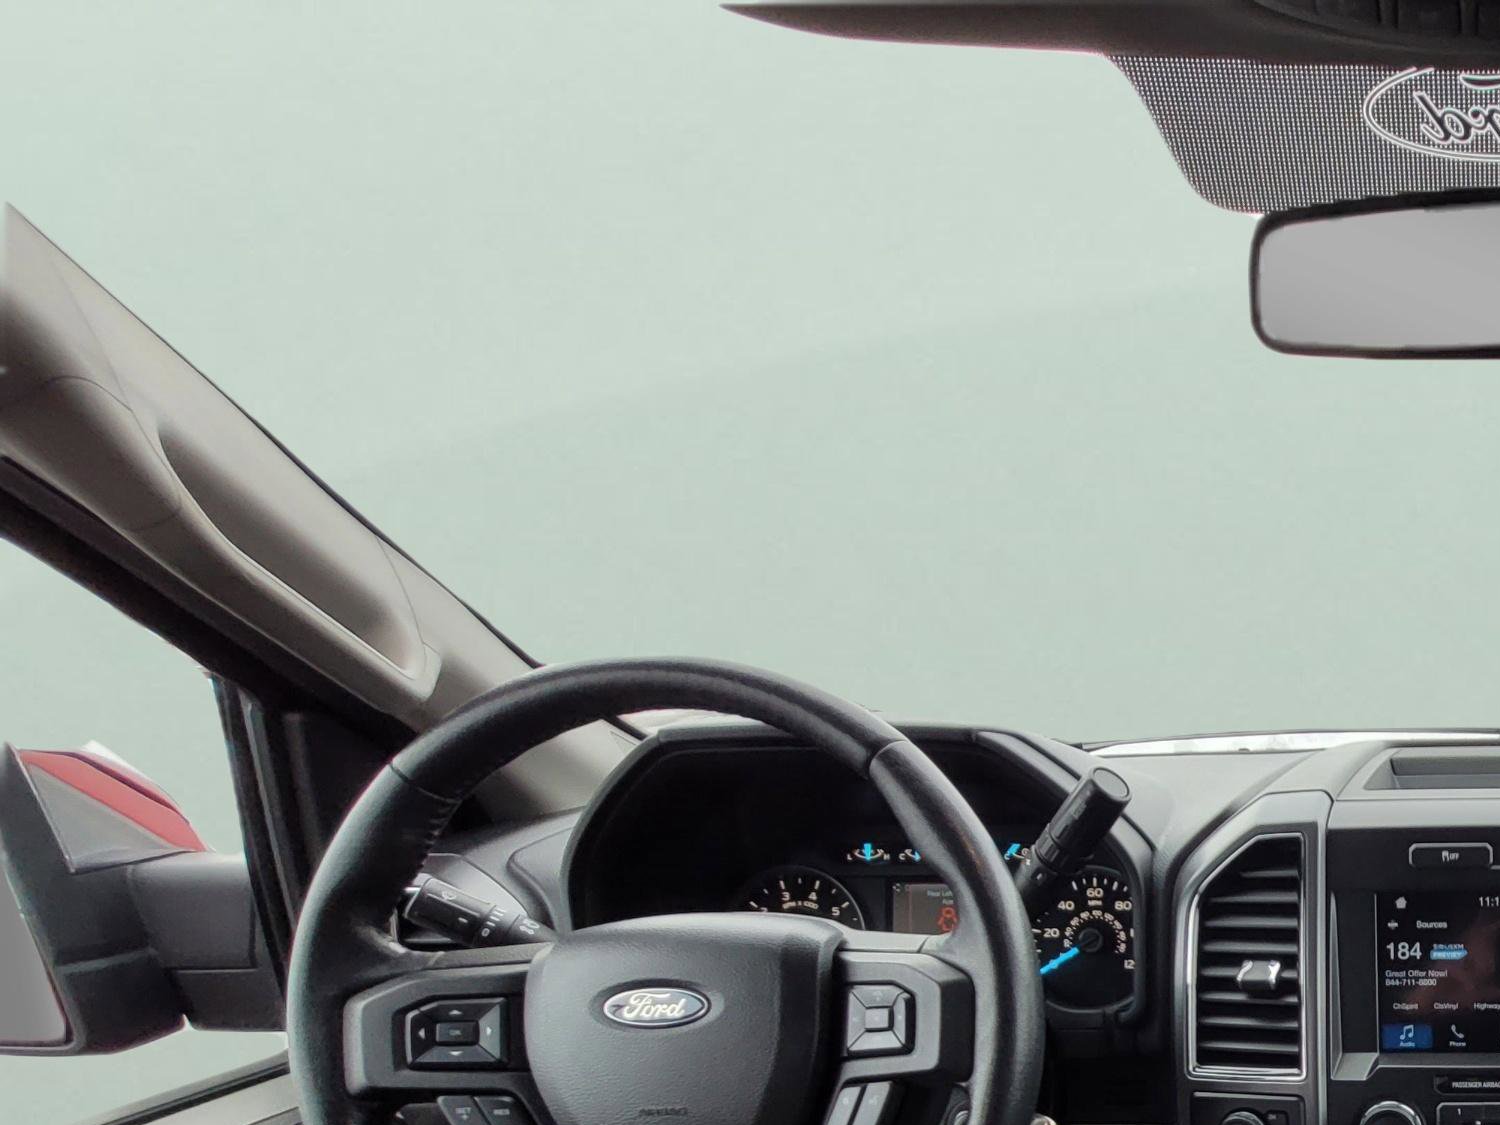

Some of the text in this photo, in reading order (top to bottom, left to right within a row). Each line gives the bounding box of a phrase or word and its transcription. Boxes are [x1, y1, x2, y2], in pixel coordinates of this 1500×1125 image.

[782, 892, 790, 900] 3
[808, 892, 817, 900] 4
[1086, 888, 1103, 897] 60
[1058, 901, 1074, 910] 40
[1115, 901, 1131, 910] 80
[832, 907, 840, 915] 5
[1416, 920, 1447, 928] Sources
[1044, 929, 1059, 938] 20
[1386, 942, 1422, 960] 184
[622, 993, 687, 1020] Ford
